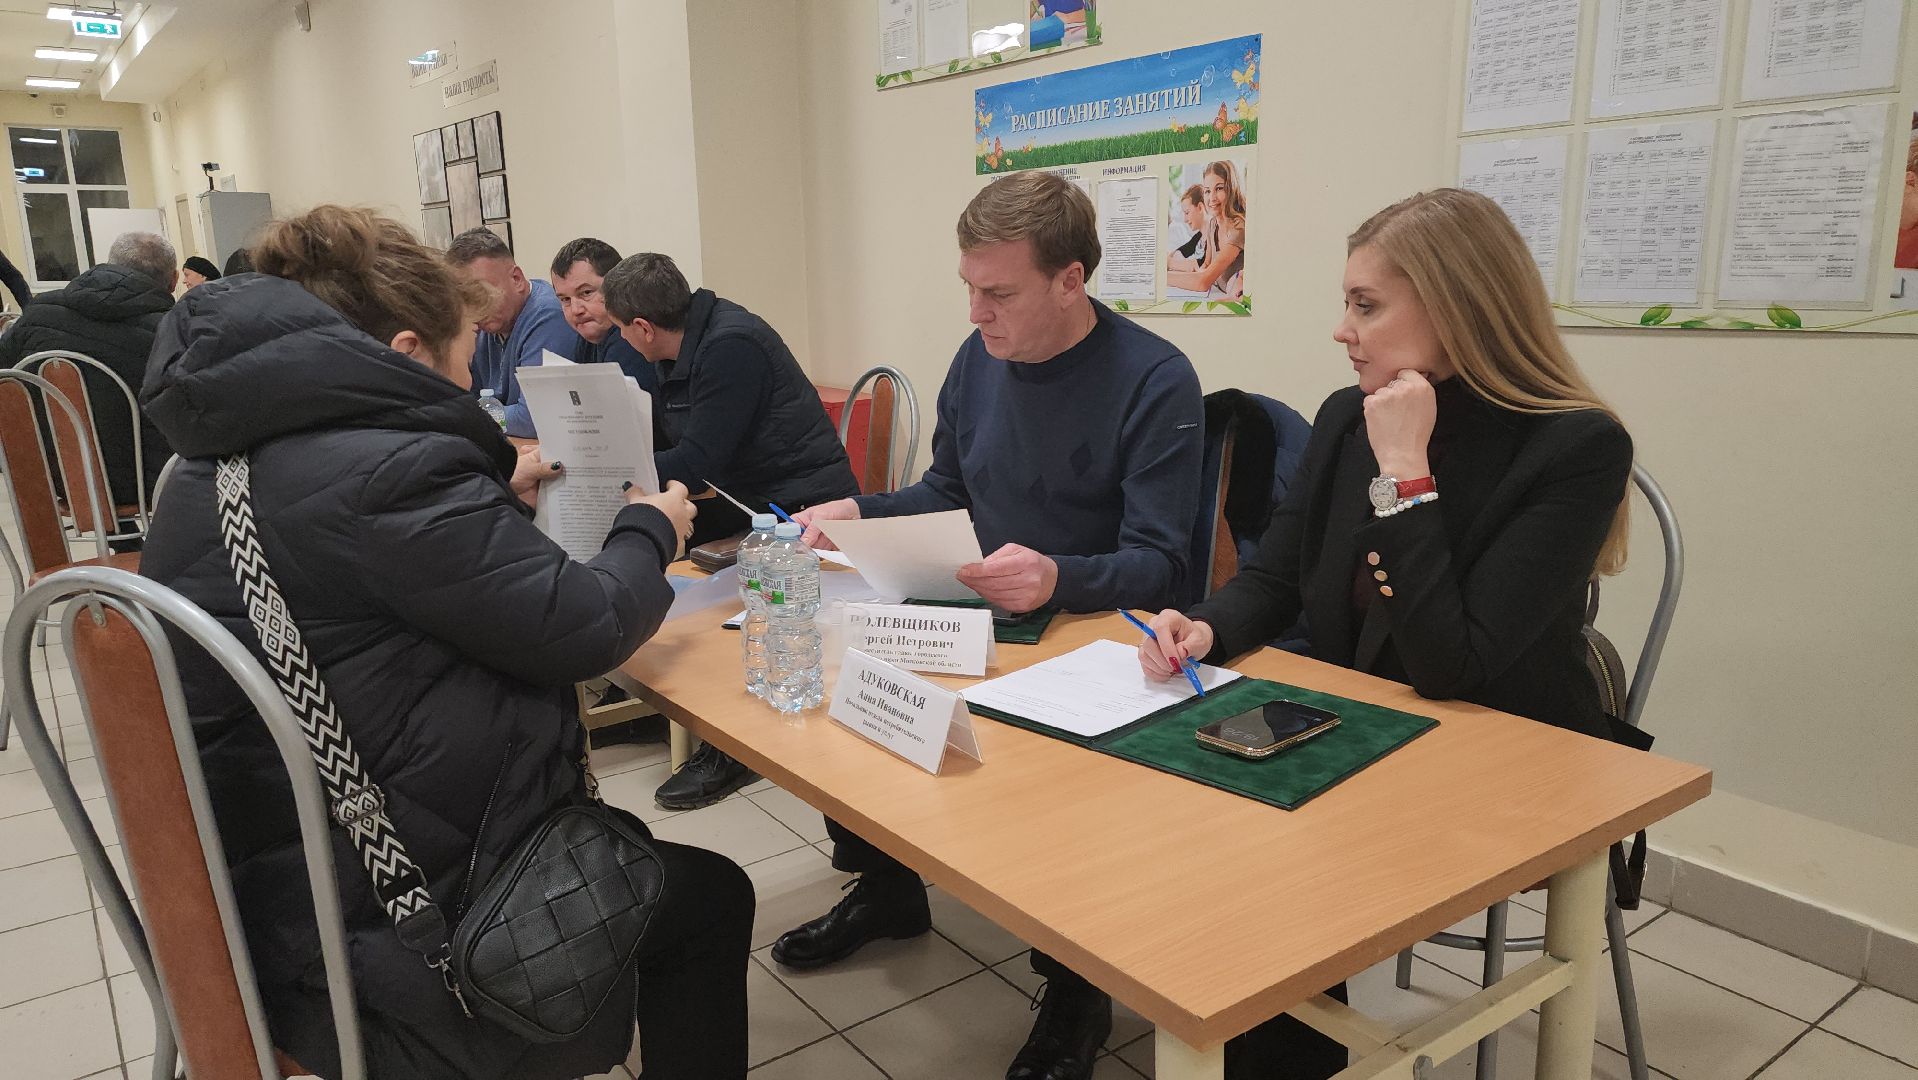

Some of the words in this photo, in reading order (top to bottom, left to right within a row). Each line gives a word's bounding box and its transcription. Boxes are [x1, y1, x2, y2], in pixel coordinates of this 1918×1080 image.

[1011, 98, 1111, 133] РАСПИСАНИЕ
[1114, 80, 1202, 118] ЗАНЯТИЙ
[1102, 164, 1147, 177] ИНФОРМАЦИЯ
[896, 635, 954, 649] Петрович
[857, 689, 877, 706] Анна
[877, 697, 915, 725] Ивановна
[858, 669, 926, 710] АДУКОВСКАЯ
